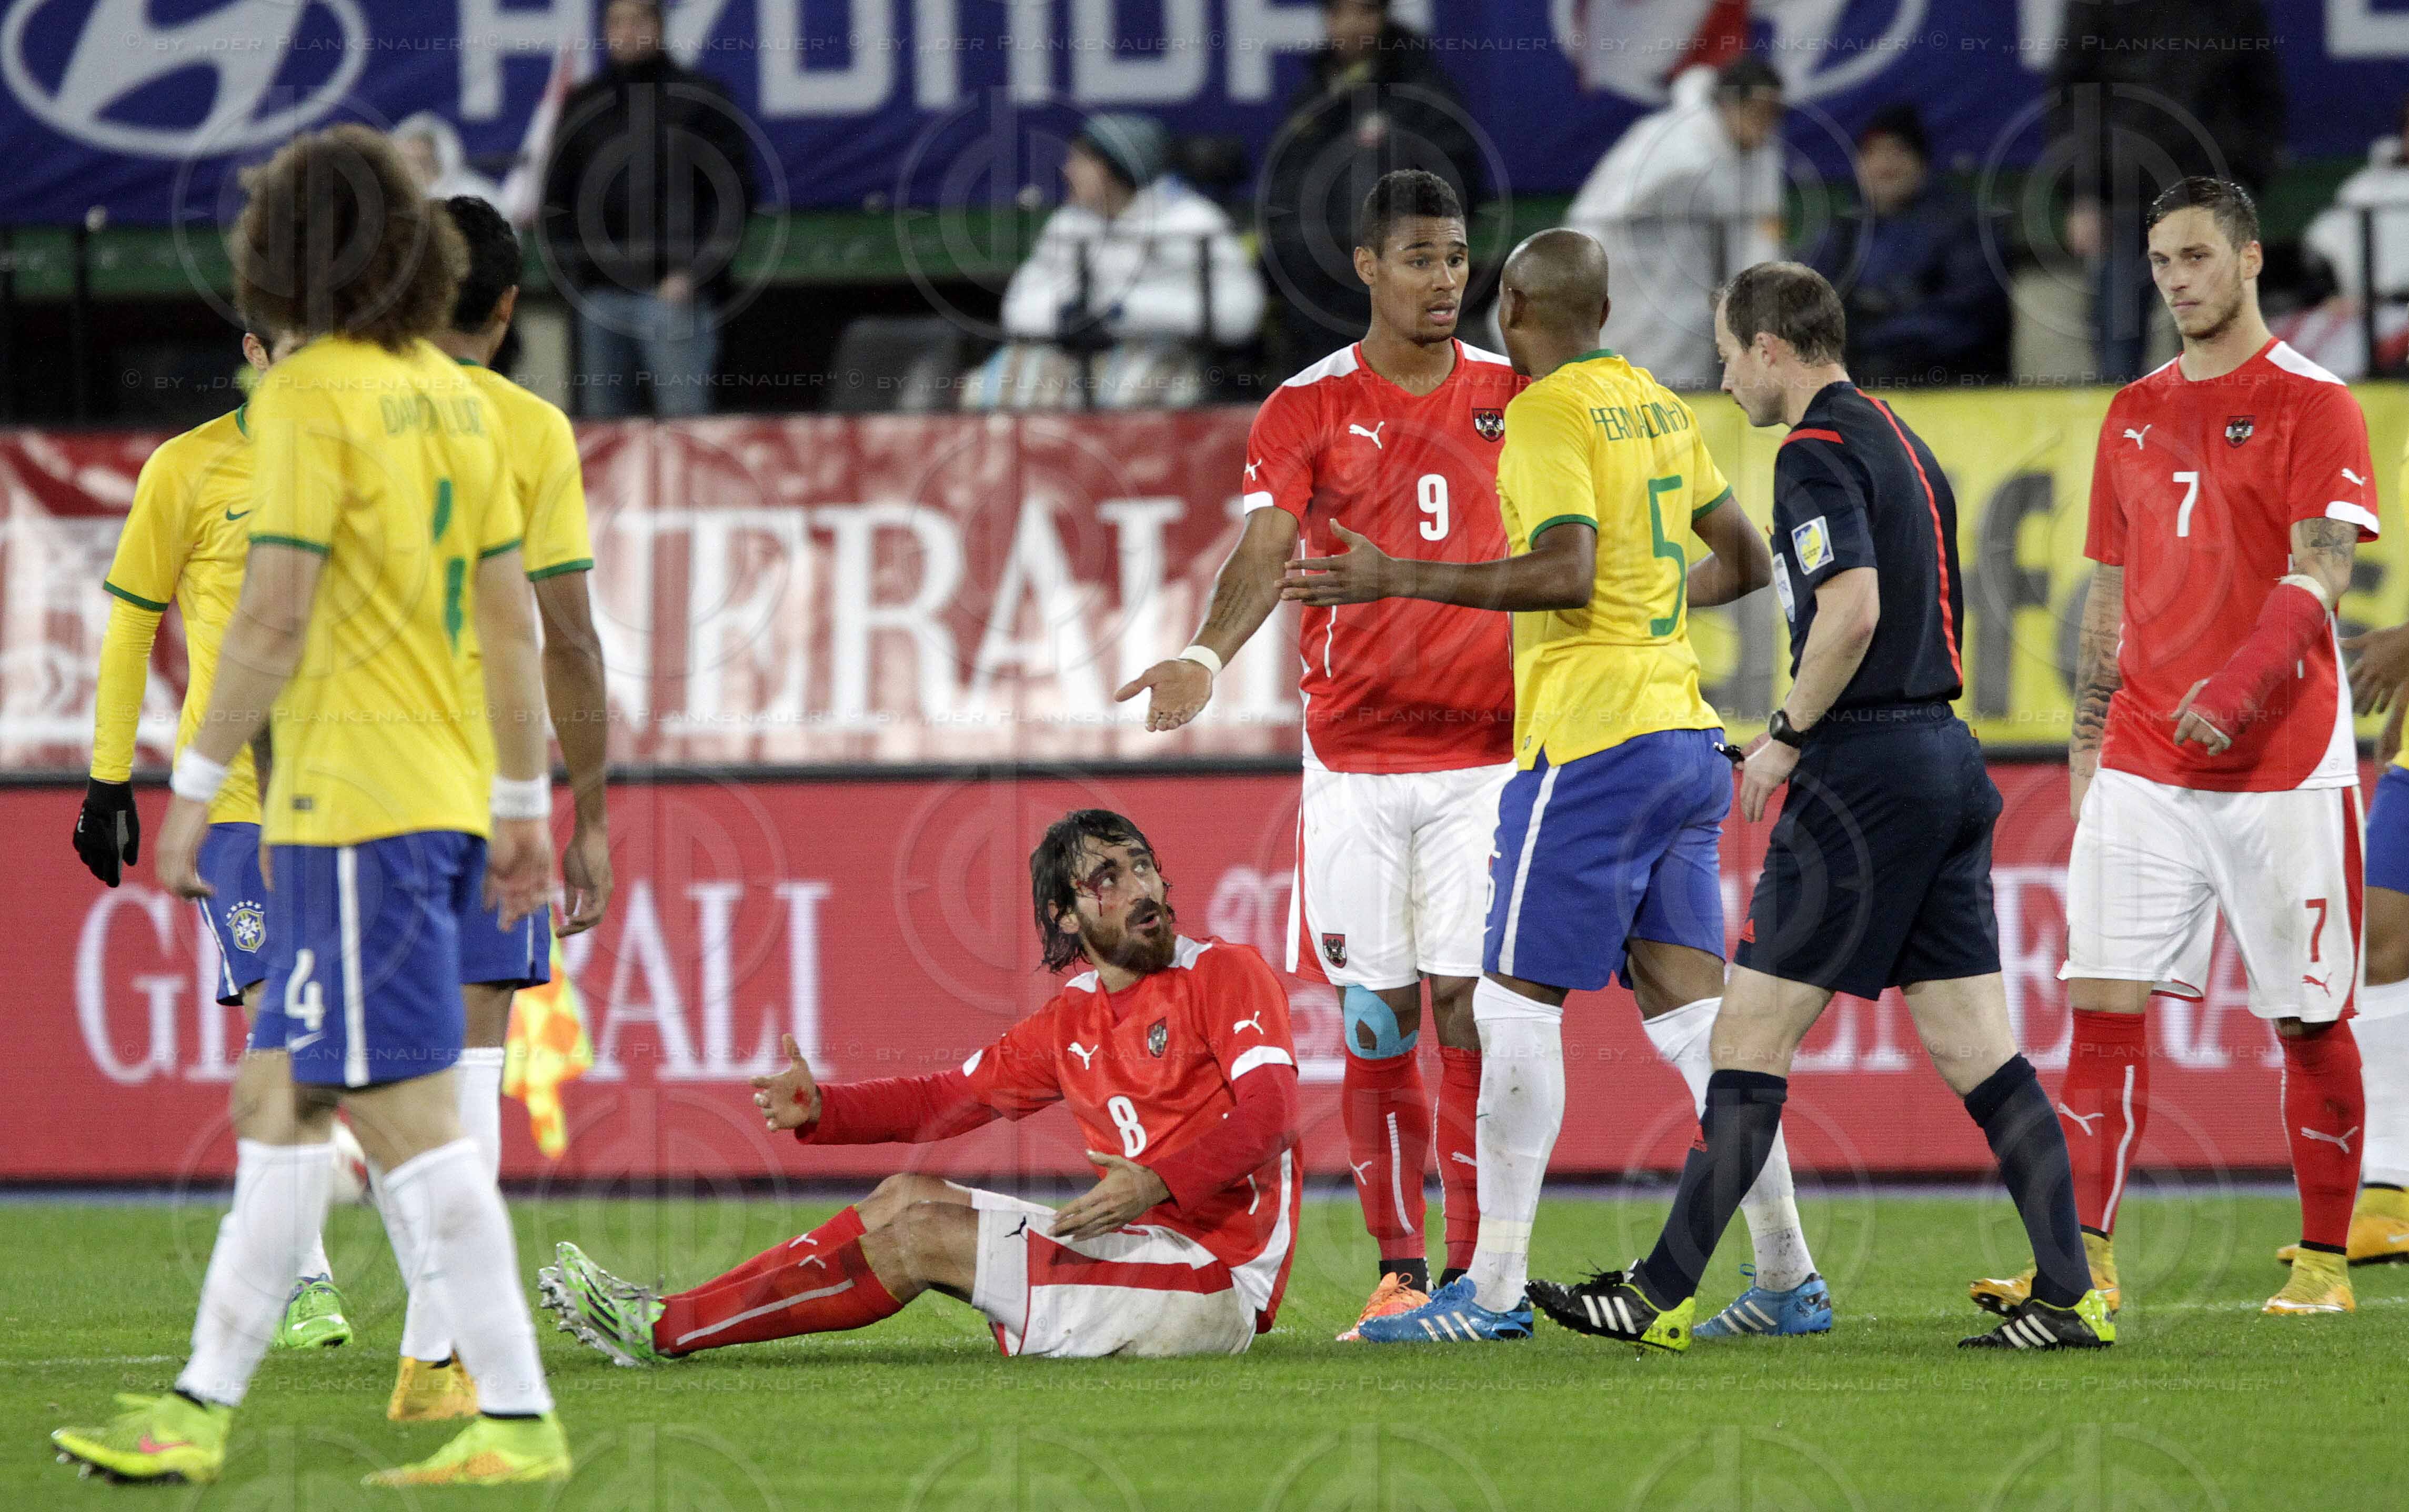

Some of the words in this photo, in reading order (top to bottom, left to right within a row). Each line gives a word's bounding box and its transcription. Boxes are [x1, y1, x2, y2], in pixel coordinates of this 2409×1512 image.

[1417, 473, 1449, 541] 9
[2173, 471, 2199, 537] 7
[1648, 475, 1687, 636] 5
[2305, 898, 2326, 963] 7
[284, 948, 325, 1030] 4
[1107, 1095, 1147, 1158] 8
